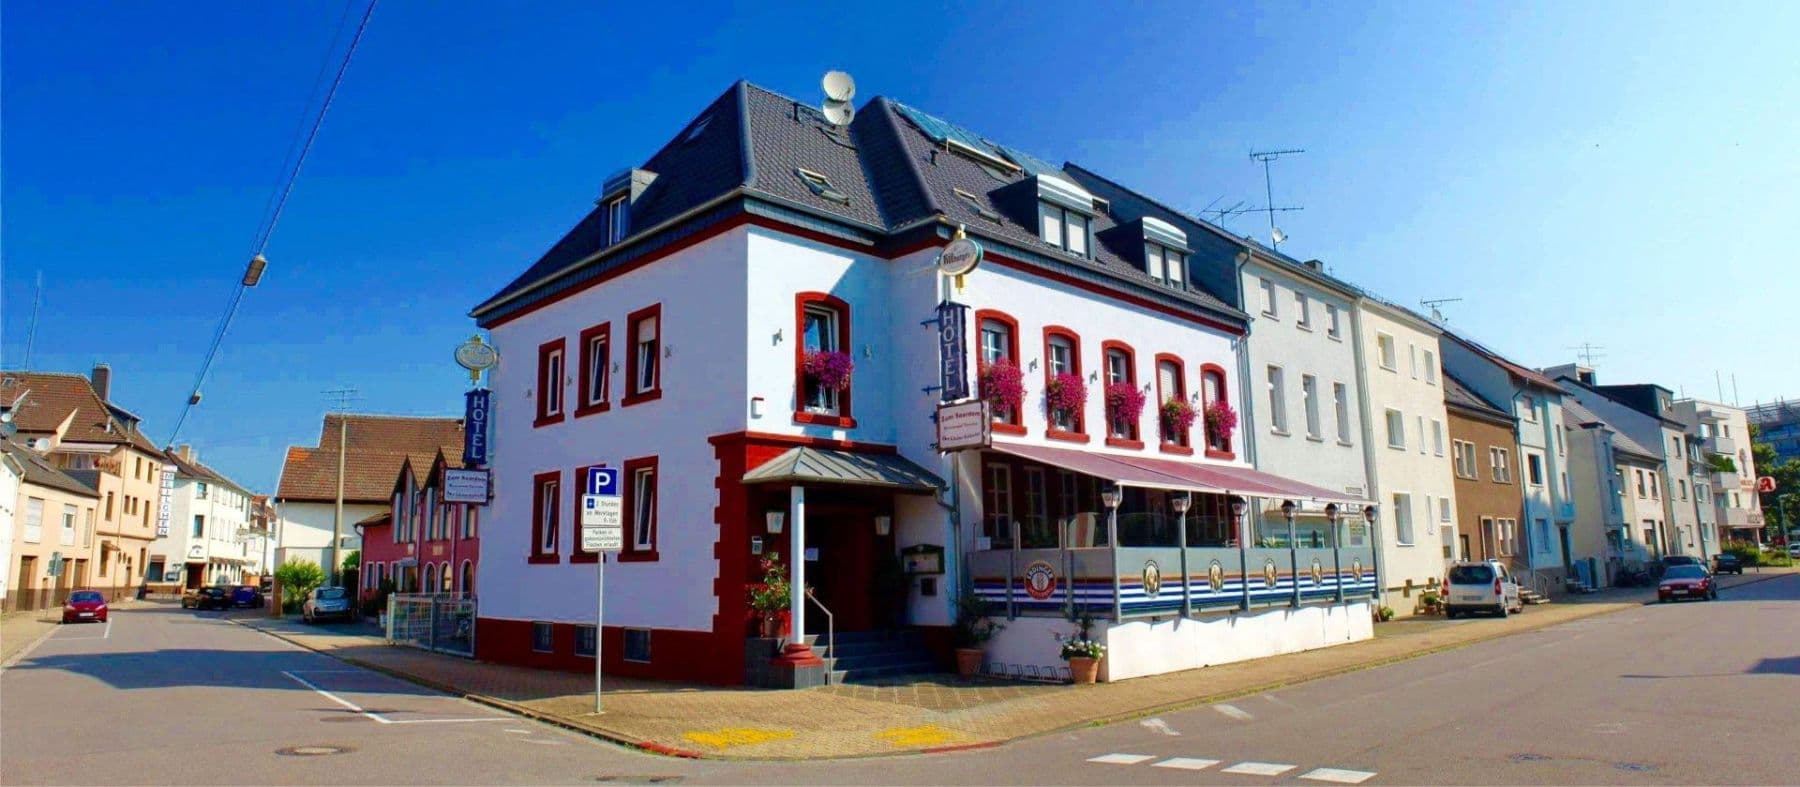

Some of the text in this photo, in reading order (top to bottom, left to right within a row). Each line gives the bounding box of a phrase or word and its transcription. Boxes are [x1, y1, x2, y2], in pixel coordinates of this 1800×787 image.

[943, 310, 955, 391] HOTEL
[472, 395, 485, 459] HOTEL
[595, 472, 611, 494] P
